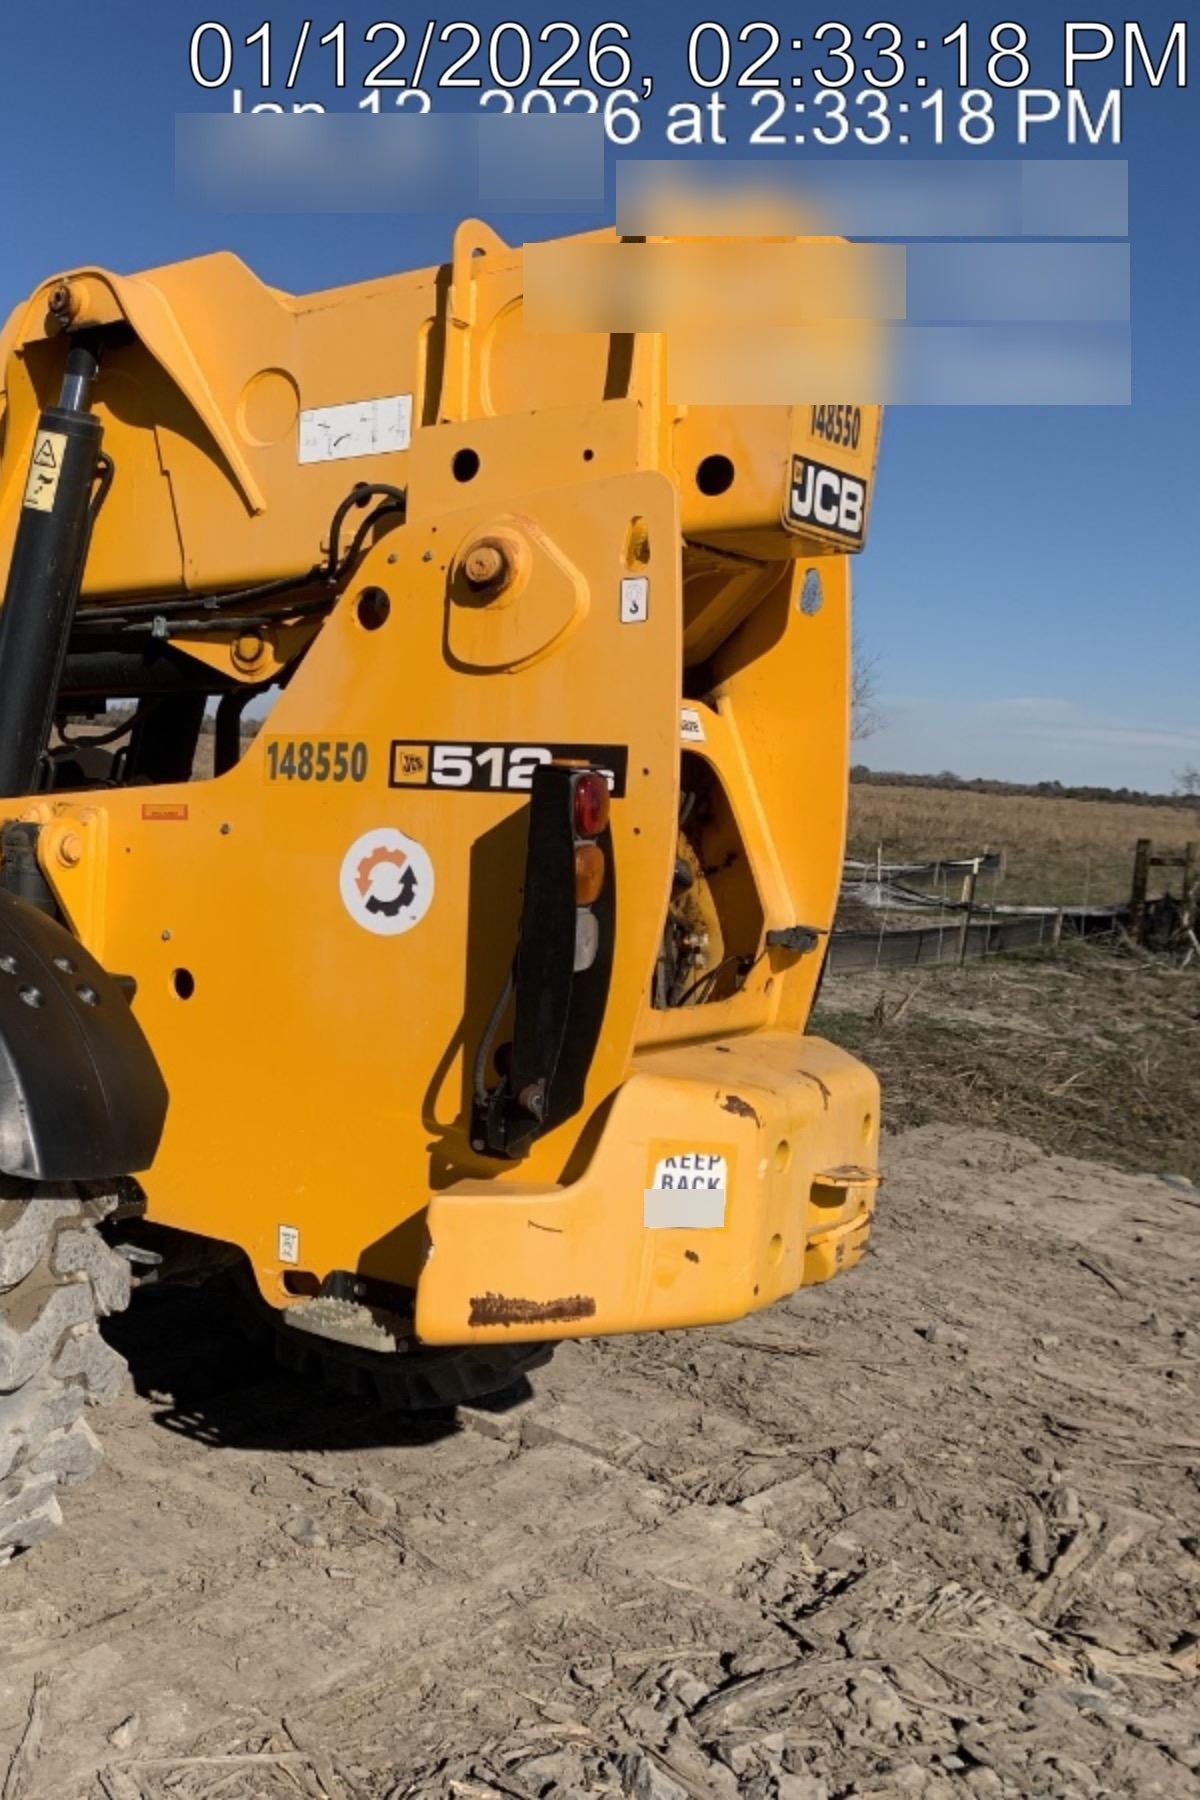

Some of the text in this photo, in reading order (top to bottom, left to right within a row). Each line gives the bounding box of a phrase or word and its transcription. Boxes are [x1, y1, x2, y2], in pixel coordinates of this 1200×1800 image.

[811, 404, 861, 450] 148550
[791, 465, 864, 533] JCB
[267, 741, 368, 782] 148550
[431, 745, 552, 789] 512
